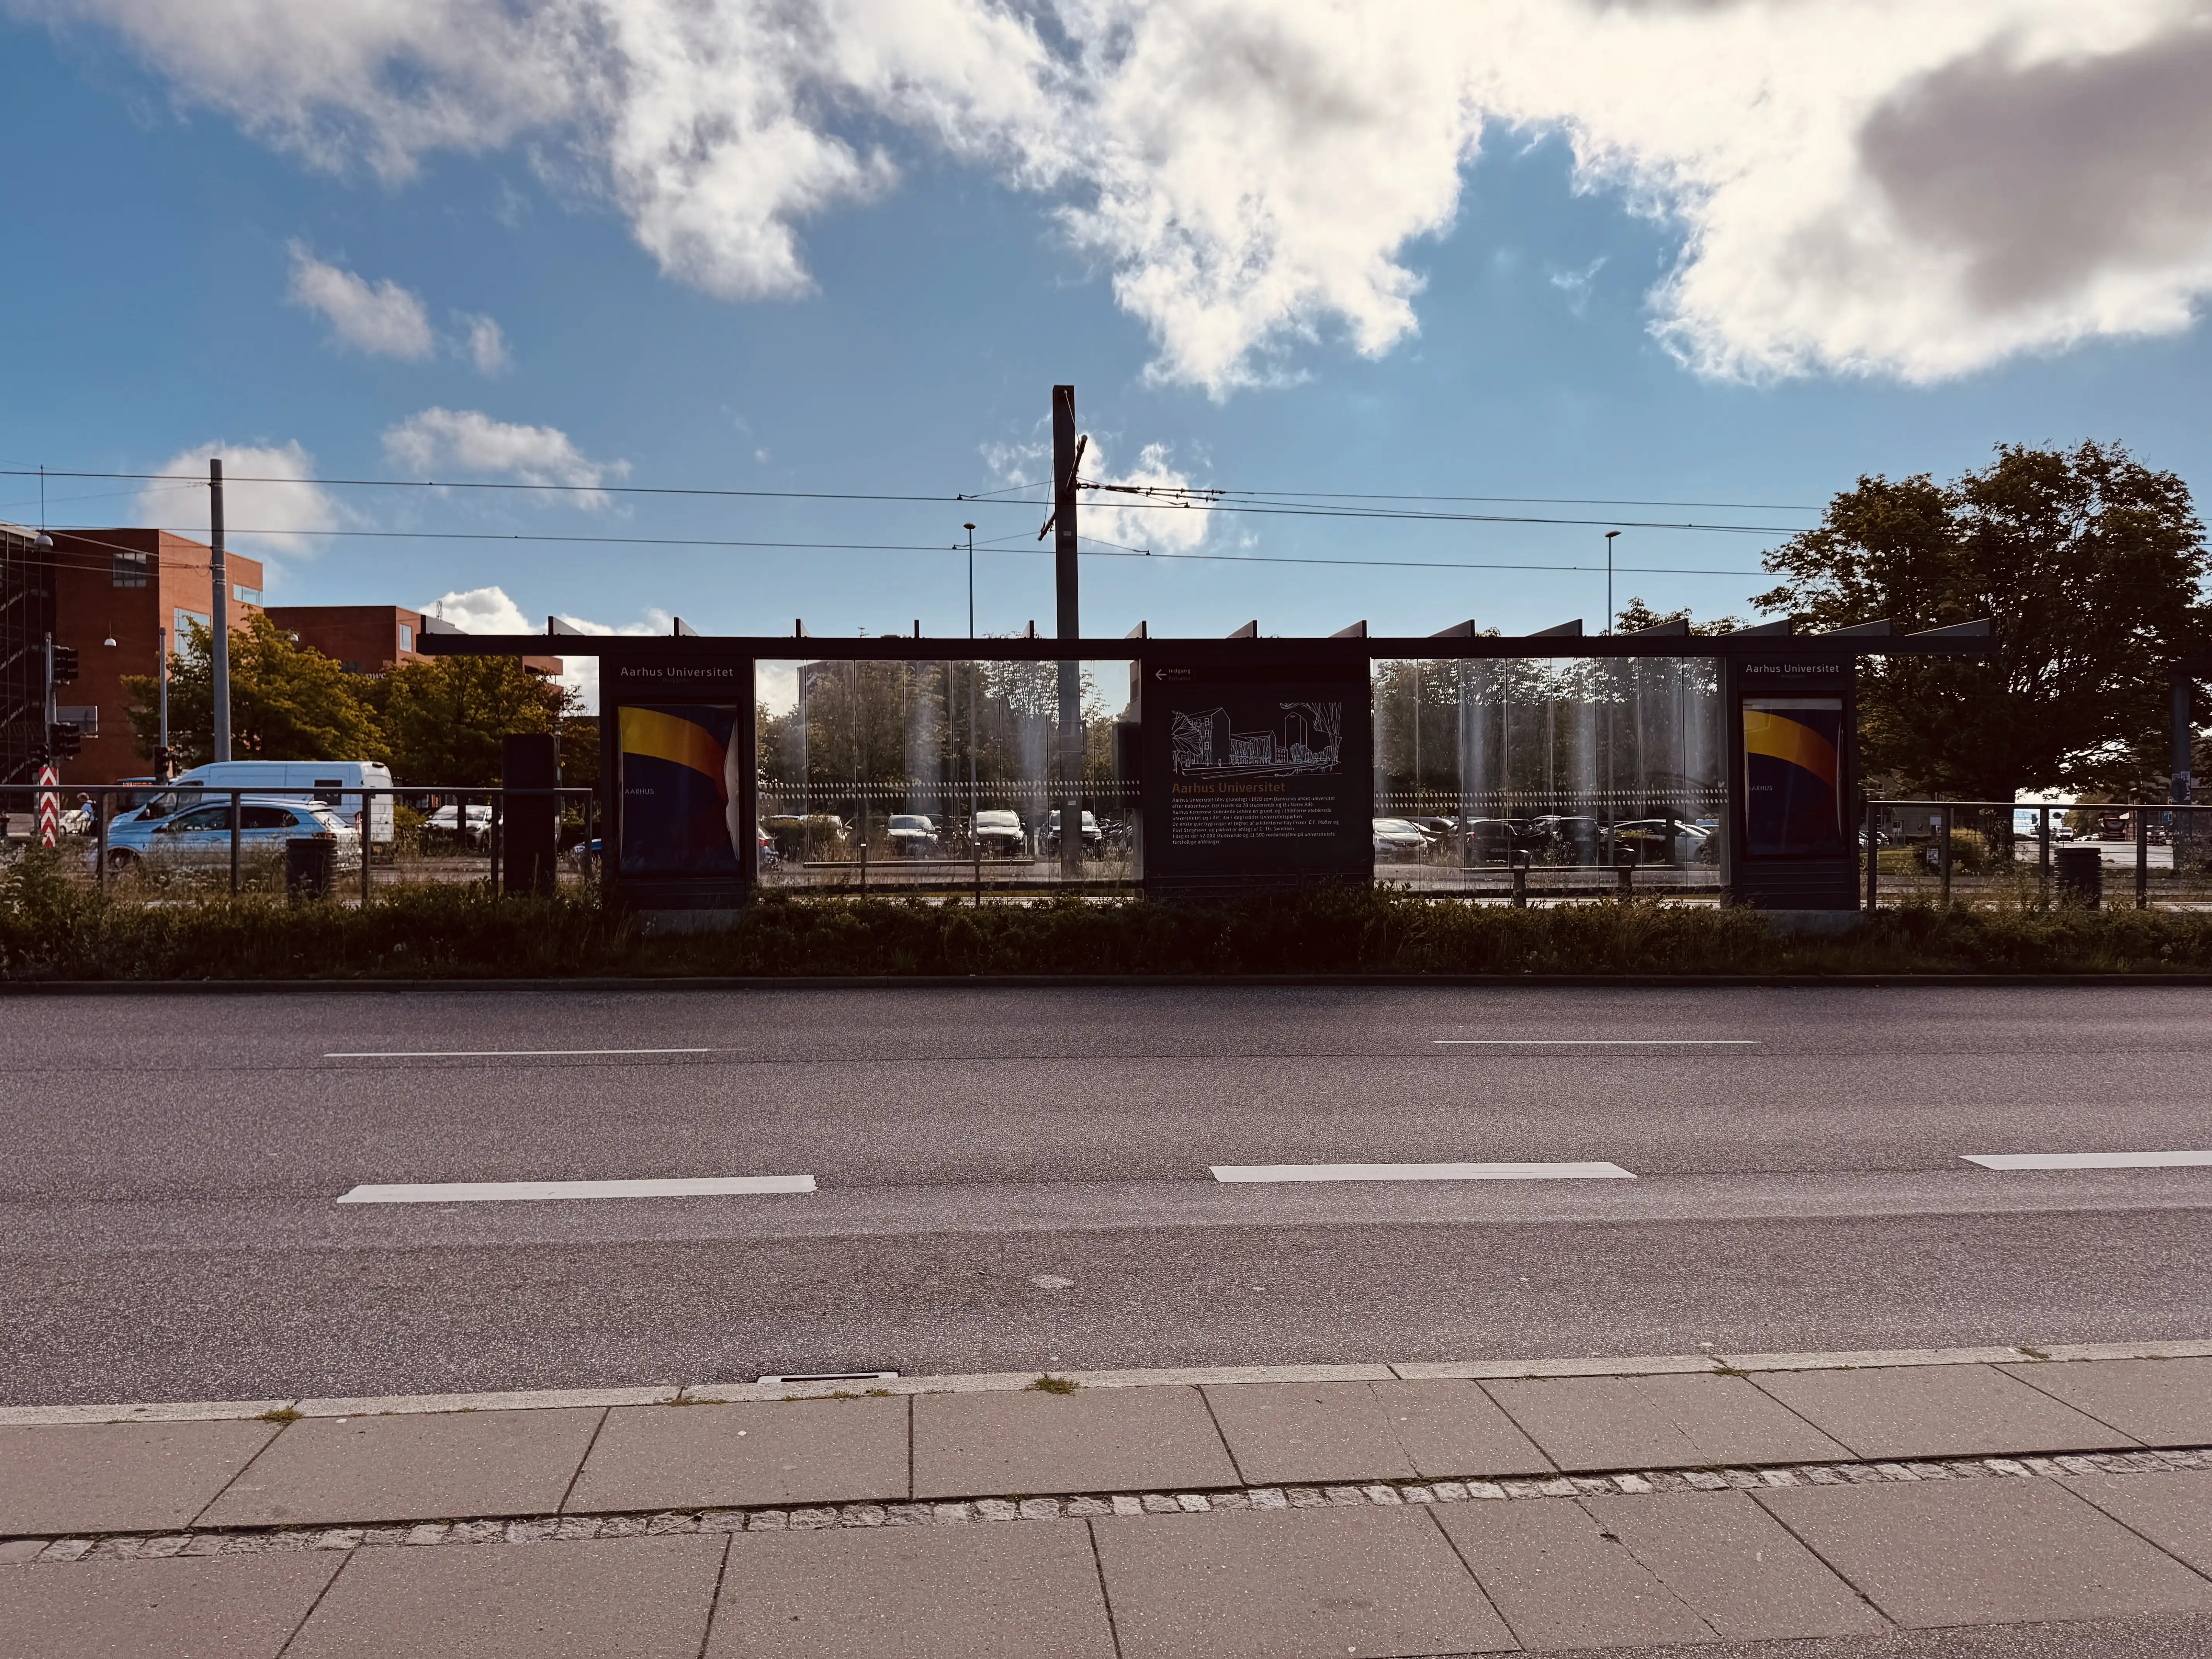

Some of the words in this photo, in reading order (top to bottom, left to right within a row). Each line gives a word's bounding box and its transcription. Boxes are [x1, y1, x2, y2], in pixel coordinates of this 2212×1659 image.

[620, 667, 662, 677] Aarhus
[667, 667, 733, 677] Universitet
[1746, 664, 1781, 673] Aarhus
[1784, 664, 1839, 672] Universitet
[1172, 782, 1215, 793] Aarhus
[1219, 781, 1286, 793] Universitet
